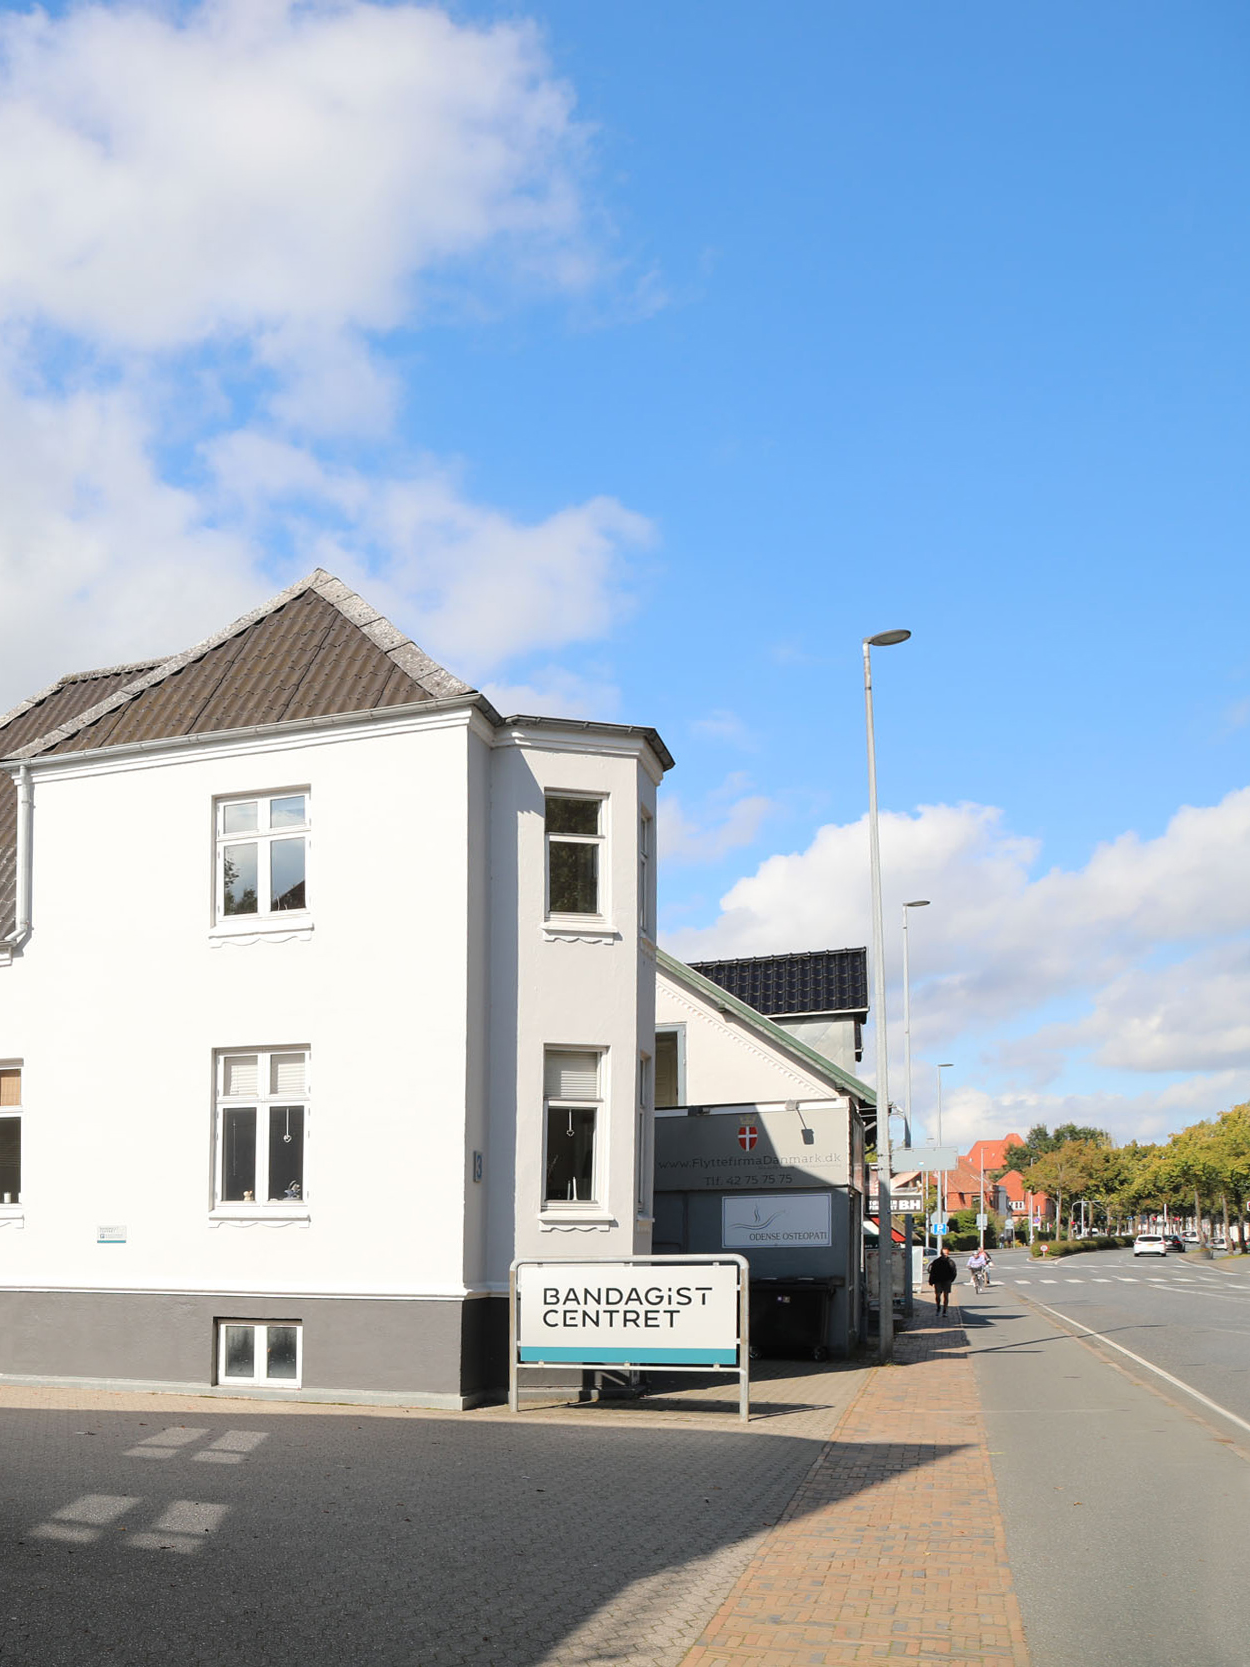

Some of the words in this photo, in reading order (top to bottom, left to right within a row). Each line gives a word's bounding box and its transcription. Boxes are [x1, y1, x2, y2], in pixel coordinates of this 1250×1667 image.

[726, 1175, 741, 1185] 42
[745, 1175, 758, 1185] 75
[763, 1174, 775, 1184] 75
[779, 1173, 792, 1184] 75
[898, 1199, 921, 1210] BH
[749, 1232, 780, 1241] ODENSE
[782, 1231, 827, 1240] OSTEOPATI
[543, 1309, 681, 1328] CENTRET
